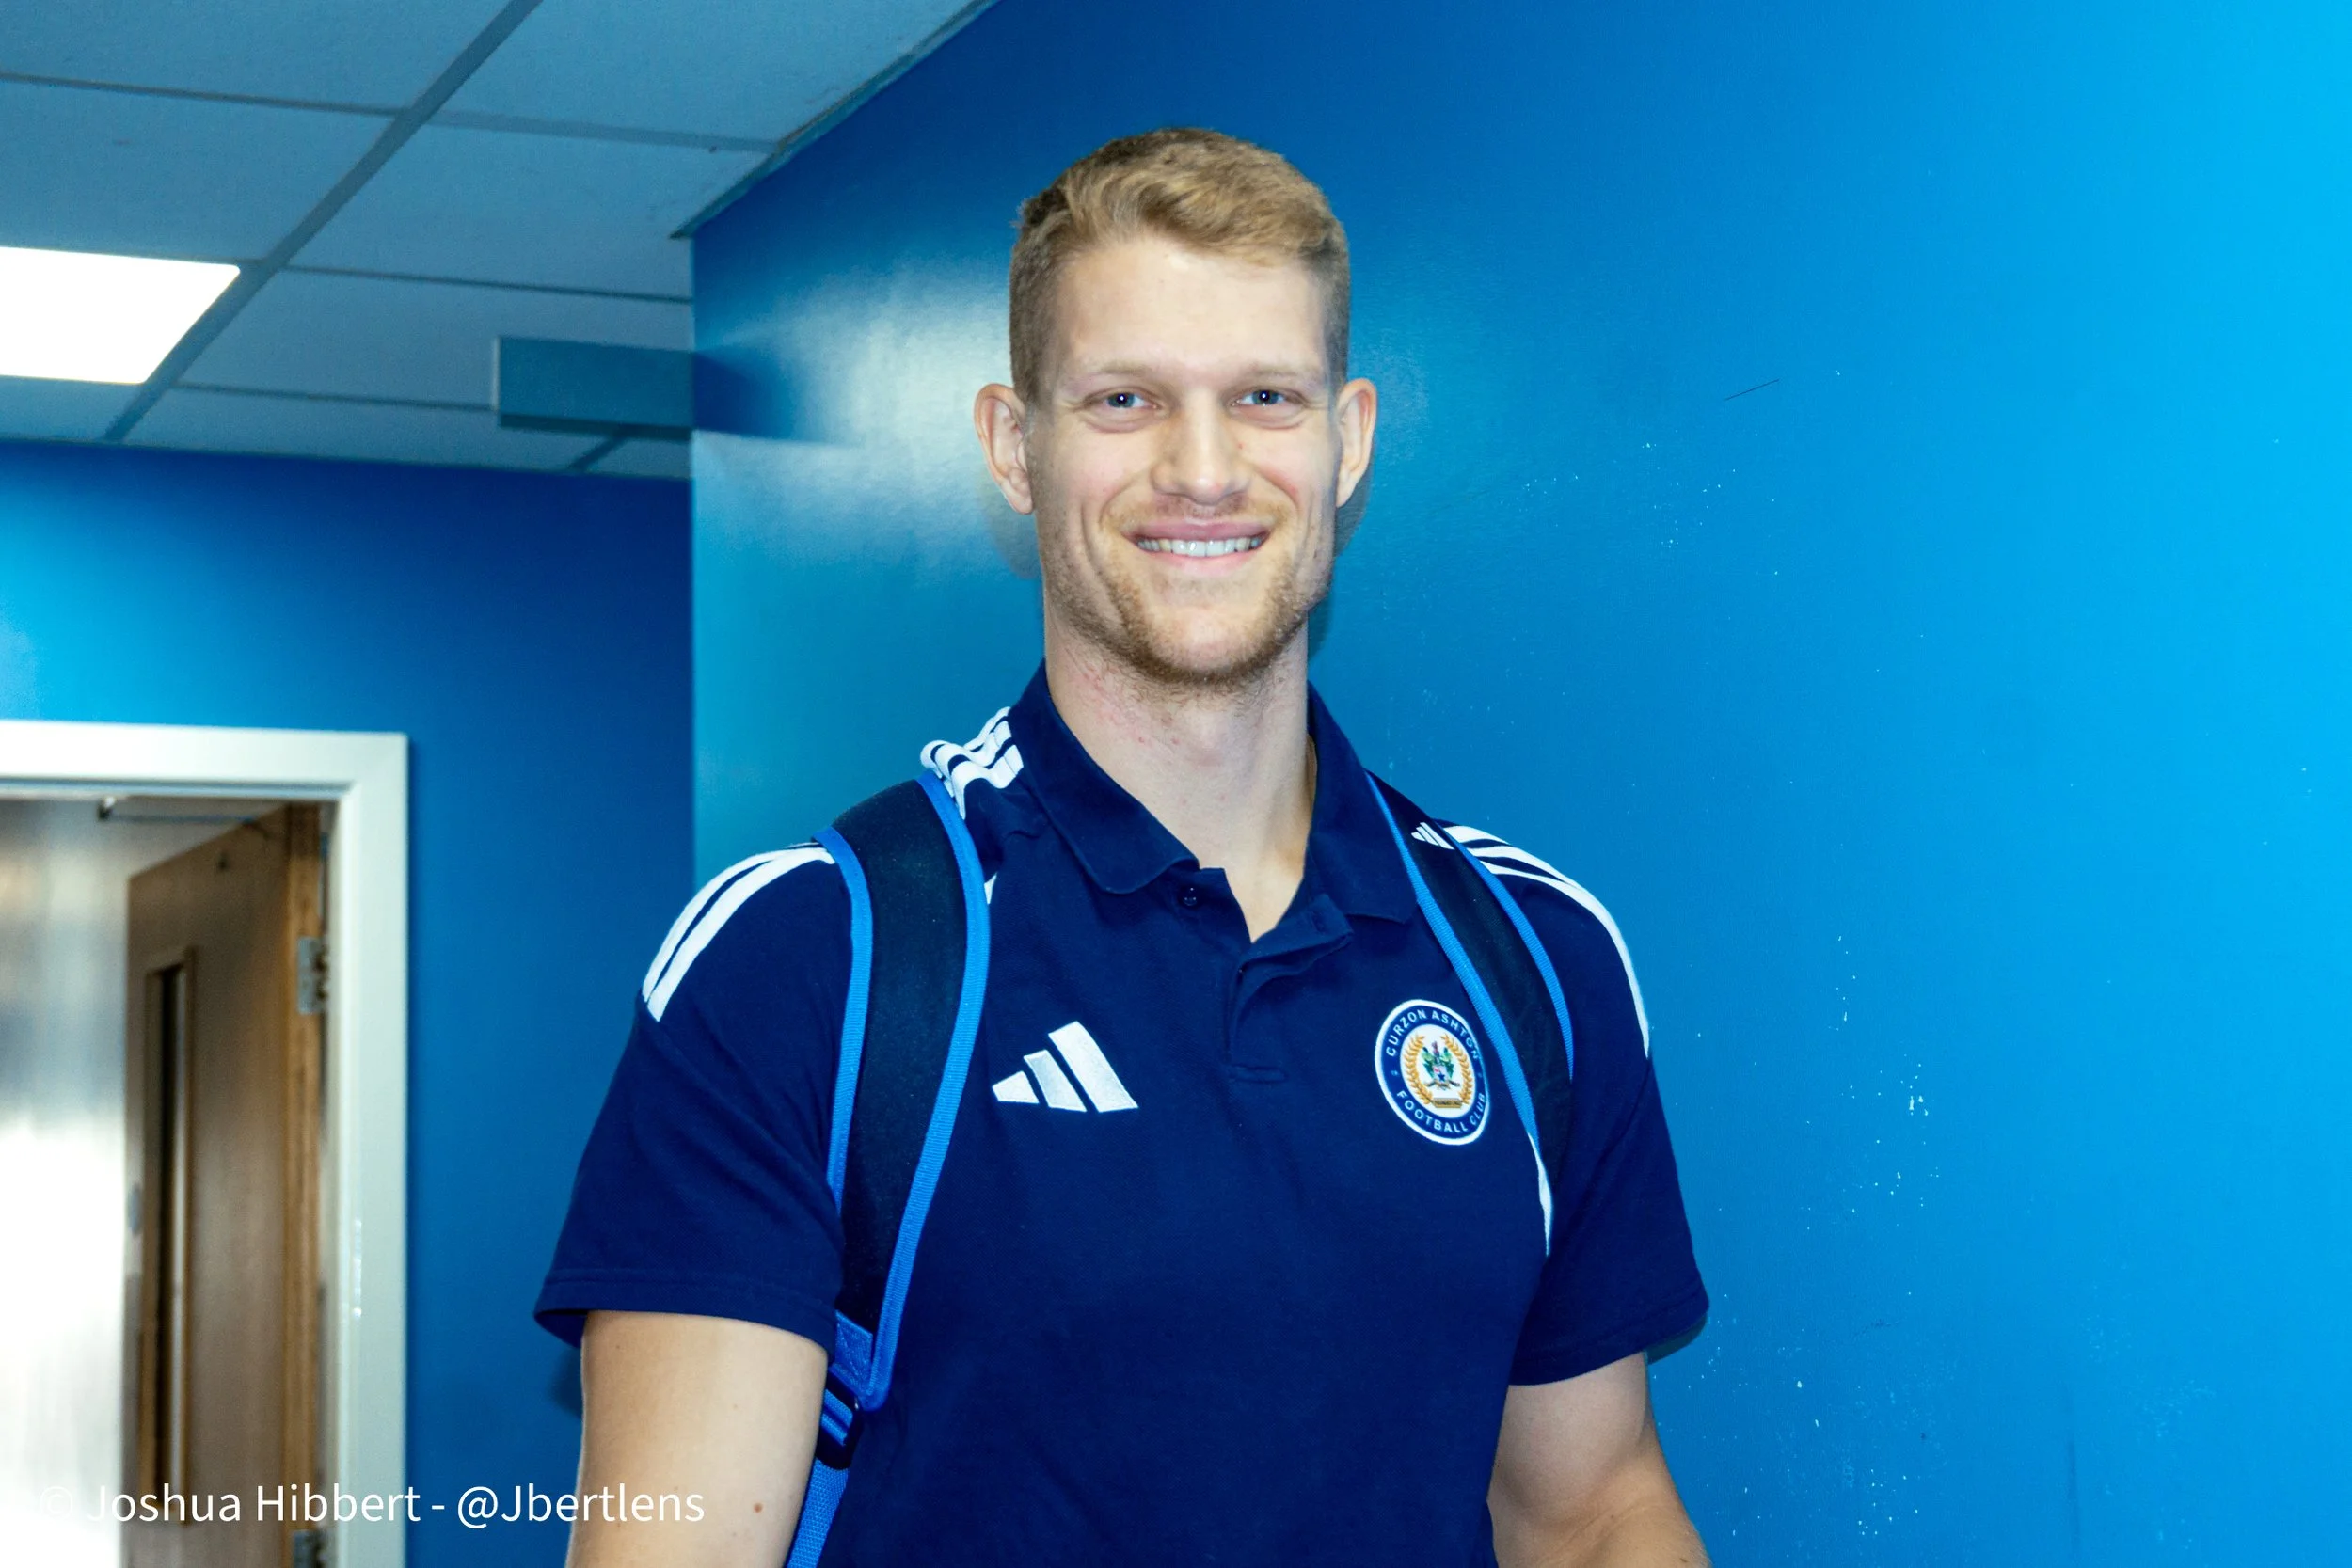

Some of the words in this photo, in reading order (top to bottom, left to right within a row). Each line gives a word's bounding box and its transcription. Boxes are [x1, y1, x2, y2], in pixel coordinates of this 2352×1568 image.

[1386, 1008, 1427, 1057] CURZON
[1431, 1010, 1479, 1060] ASHTON
[1396, 1090, 1469, 1133] FOOTBALL
[1470, 1092, 1486, 1125] CLUB
